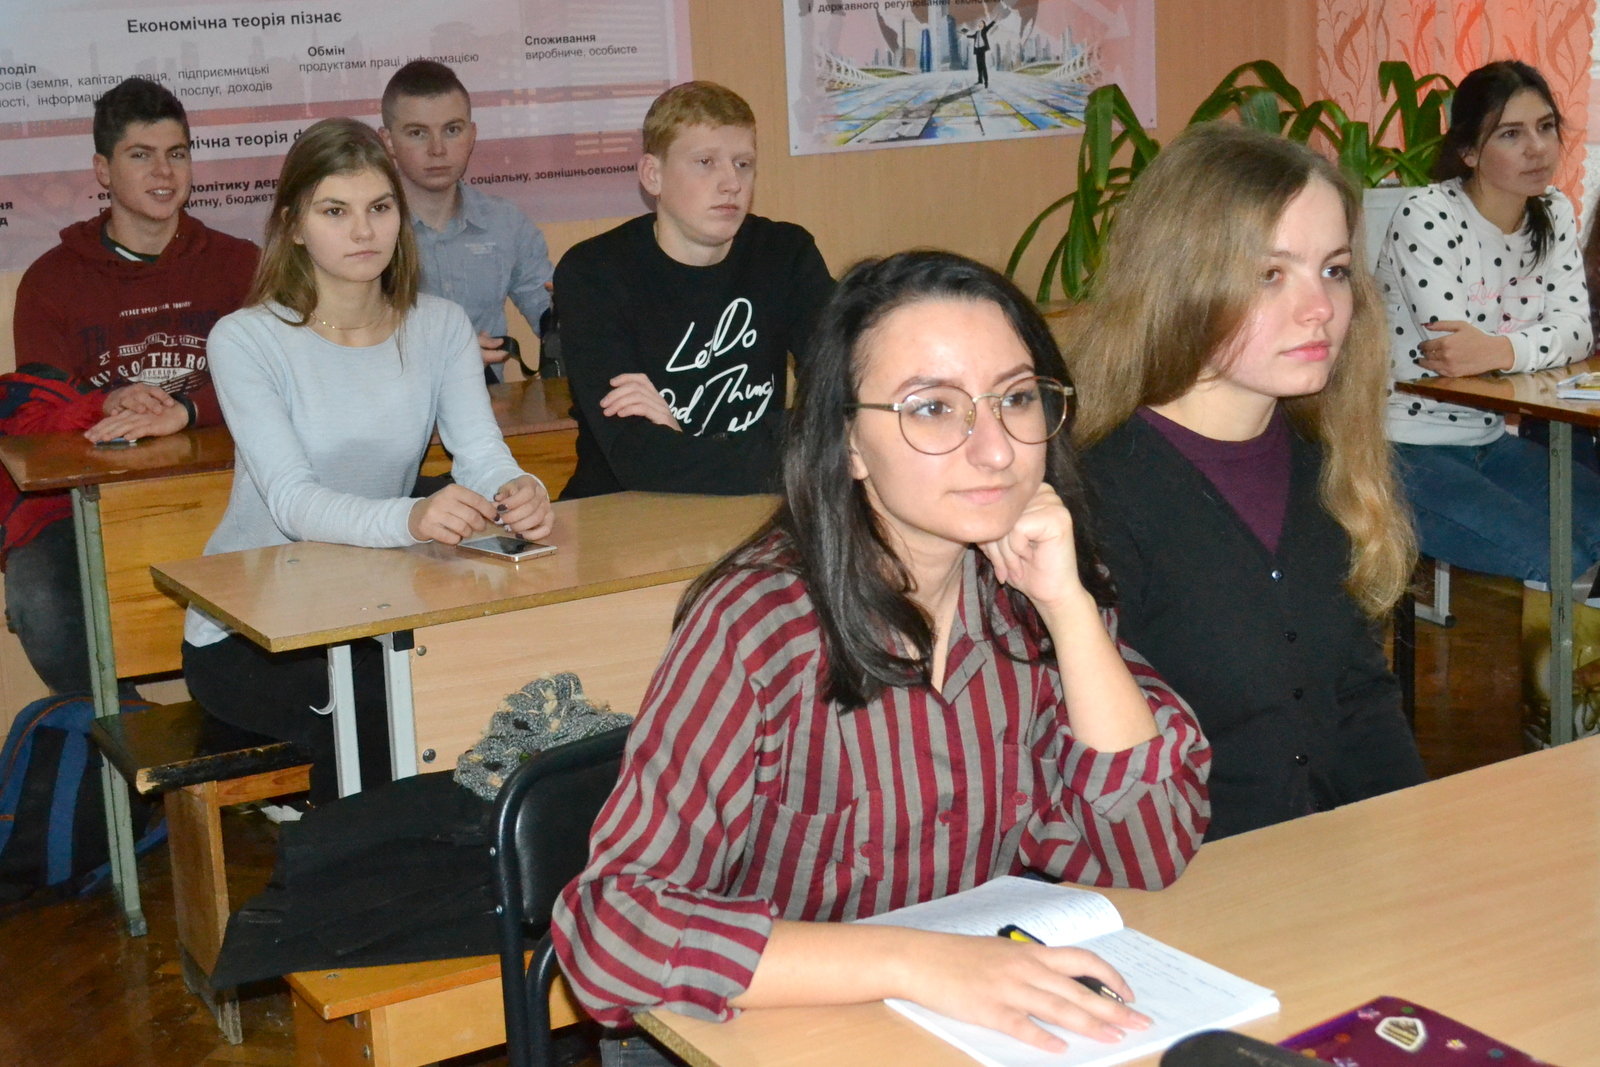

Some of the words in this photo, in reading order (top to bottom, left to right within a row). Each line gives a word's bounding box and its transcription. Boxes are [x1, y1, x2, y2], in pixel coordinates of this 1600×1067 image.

[817, 1, 880, 13] державного
[127, 16, 227, 33] Економічна
[232, 12, 285, 29] теорія
[290, 11, 342, 25] пізнає
[524, 34, 596, 46] Споживання
[307, 45, 345, 57] Обмін
[525, 48, 586, 60] виробниче,
[588, 45, 637, 56] особисте
[299, 60, 367, 73] продуктами
[370, 56, 403, 69] праці,
[26, 78, 73, 91] (земля,
[178, 64, 270, 80] підприємницькі
[37, 91, 104, 107] інформаці
[180, 86, 222, 98] послуг,
[227, 81, 273, 94] доходів
[235, 130, 288, 147] теорія
[470, 173, 531, 185] соціальну,
[148, 352, 181, 368] THE
[185, 353, 208, 371] RO
